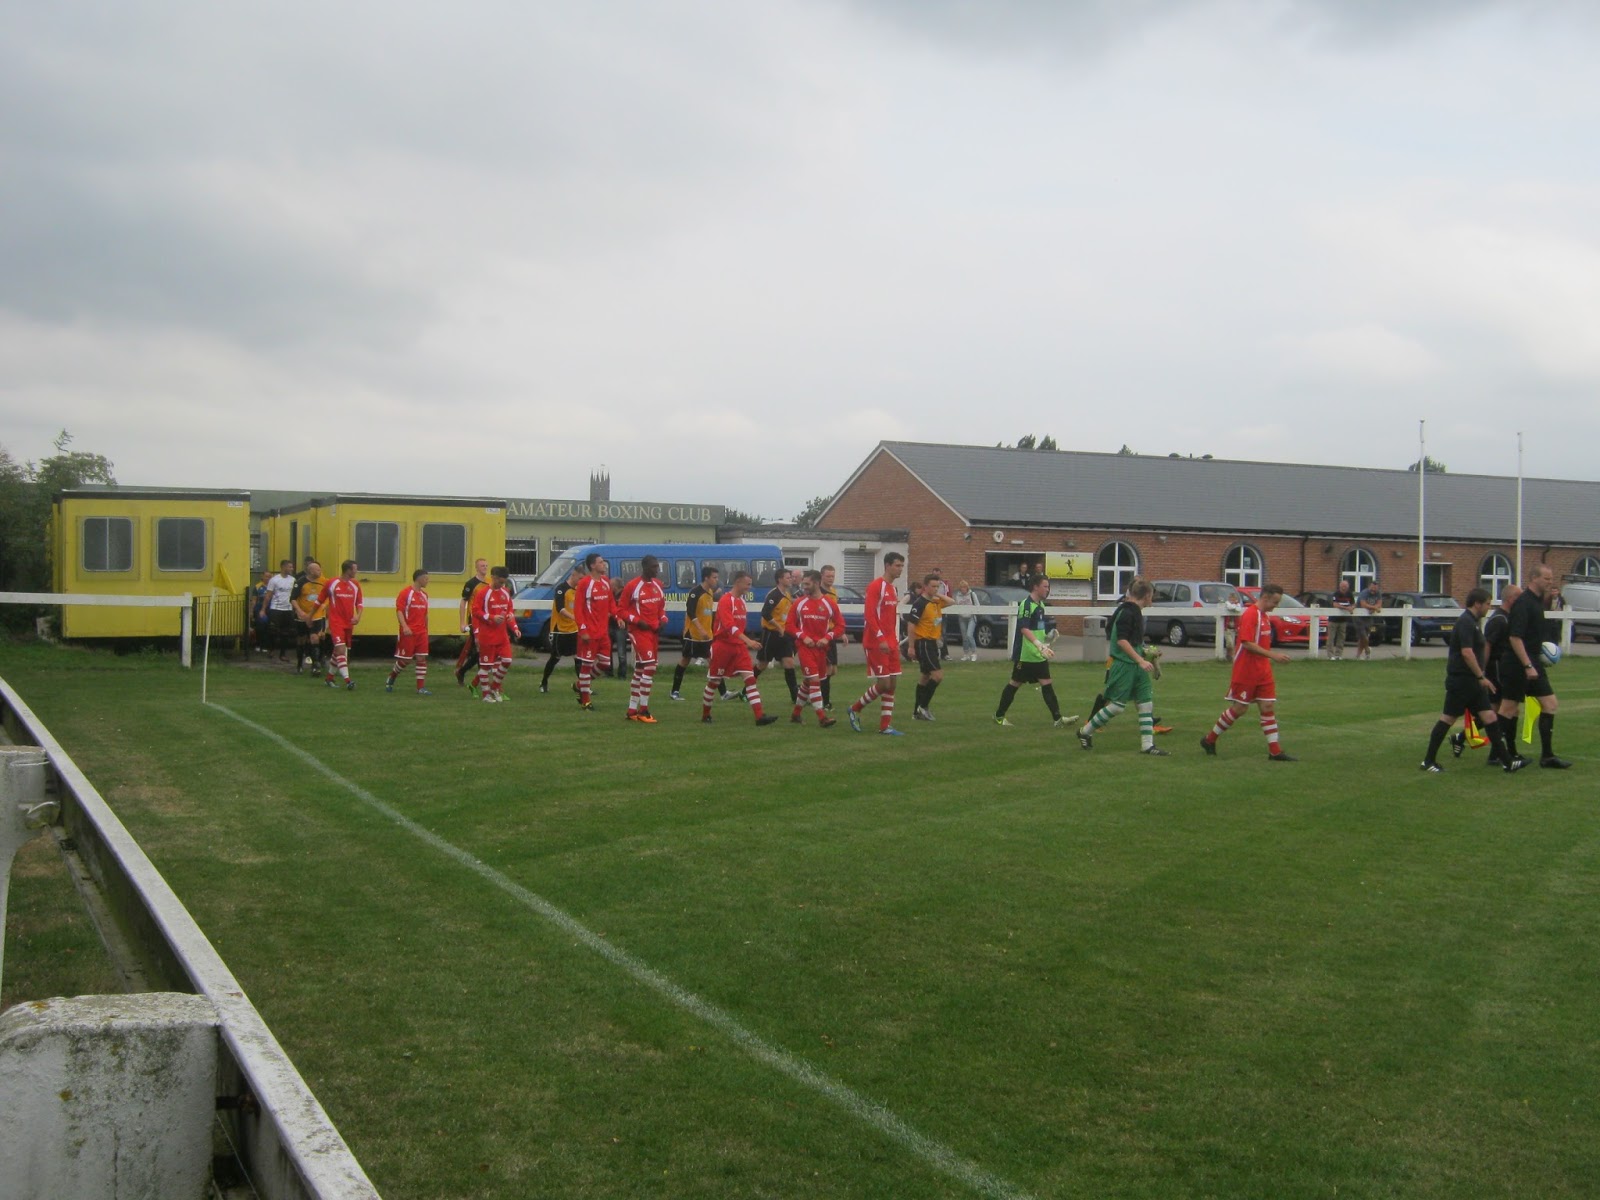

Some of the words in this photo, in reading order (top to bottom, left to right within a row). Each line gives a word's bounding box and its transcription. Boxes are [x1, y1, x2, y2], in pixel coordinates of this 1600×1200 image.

[507, 502, 592, 518] AMATEUR
[597, 505, 662, 520] BOXING
[668, 507, 711, 522] CLUB
[586, 650, 592, 658] 5
[647, 650, 653, 658] 9
[878, 665, 883, 674] 7
[1240, 691, 1247, 699] 4
